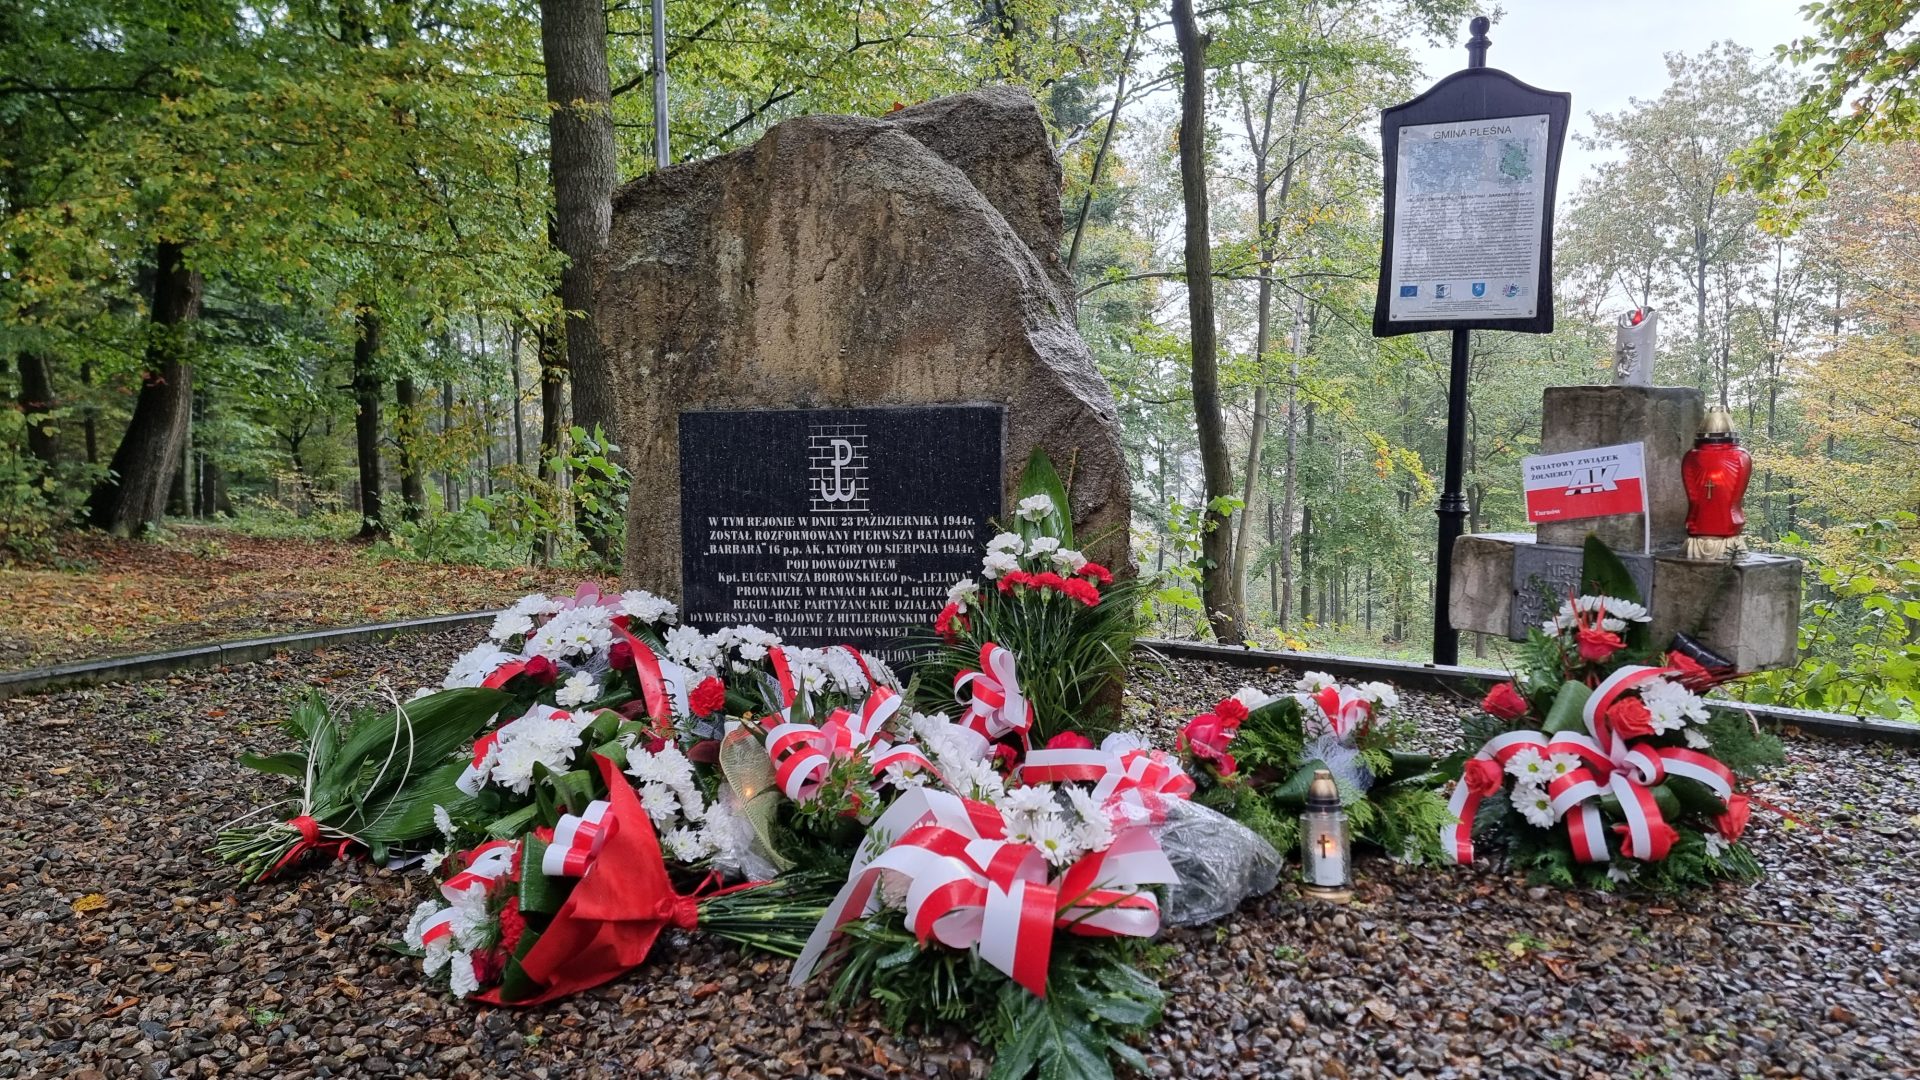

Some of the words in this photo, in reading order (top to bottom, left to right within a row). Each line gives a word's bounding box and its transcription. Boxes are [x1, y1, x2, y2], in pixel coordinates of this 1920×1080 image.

[1433, 129, 1467, 140] GMINA
[1469, 125, 1512, 136] PLEŚNA
[1530, 460, 1574, 471] ŚWIATOWY
[1577, 454, 1619, 465] ZWIĄZEK
[1530, 470, 1573, 481] ŻOŁNIERZY
[1564, 464, 1620, 496] AK
[708, 517, 719, 527] W
[721, 517, 744, 527] TYM
[747, 516, 794, 527] REJONIE
[797, 516, 809, 527] W
[812, 516, 838, 527] DNIU
[841, 516, 854, 527] 23
[856, 513, 939, 526] PAŹDZIERNIKA
[942, 515, 976, 526] 1944r.
[709, 530, 752, 541] ZOSTAŁ
[755, 530, 850, 541] ROZFORMOWANY
[853, 530, 914, 540] PIERWSZY
[916, 529, 975, 540] BATALION
[768, 544, 780, 554] 16
[783, 545, 802, 557] p.p.
[826, 542, 864, 554] KTÓRY
[866, 544, 882, 554] OD
[884, 543, 938, 554] SIERPNIA
[942, 543, 976, 554] 1944r.
[786, 559, 809, 570] POD
[811, 557, 897, 570] DOWÓDZTWEM
[718, 572, 740, 584] Kpt.
[742, 572, 811, 583] EUGENIUSZA
[813, 572, 898, 583] BOROWSKIEGO
[900, 574, 916, 585] ps.
[736, 586, 803, 597] PROWADZIŁ
[805, 586, 817, 597] W
[819, 586, 866, 597] RAMACH
[869, 586, 902, 597] AKCJI
[733, 599, 801, 610] REGULARNE
[690, 612, 766, 623] DYWERSYJNO
[827, 613, 835, 623] Z
[837, 613, 927, 623] HITLEROWSKIM
[773, 626, 788, 637] NA
[790, 626, 823, 637] ZIEMI
[825, 626, 909, 638] TARNOWSKIEJ
